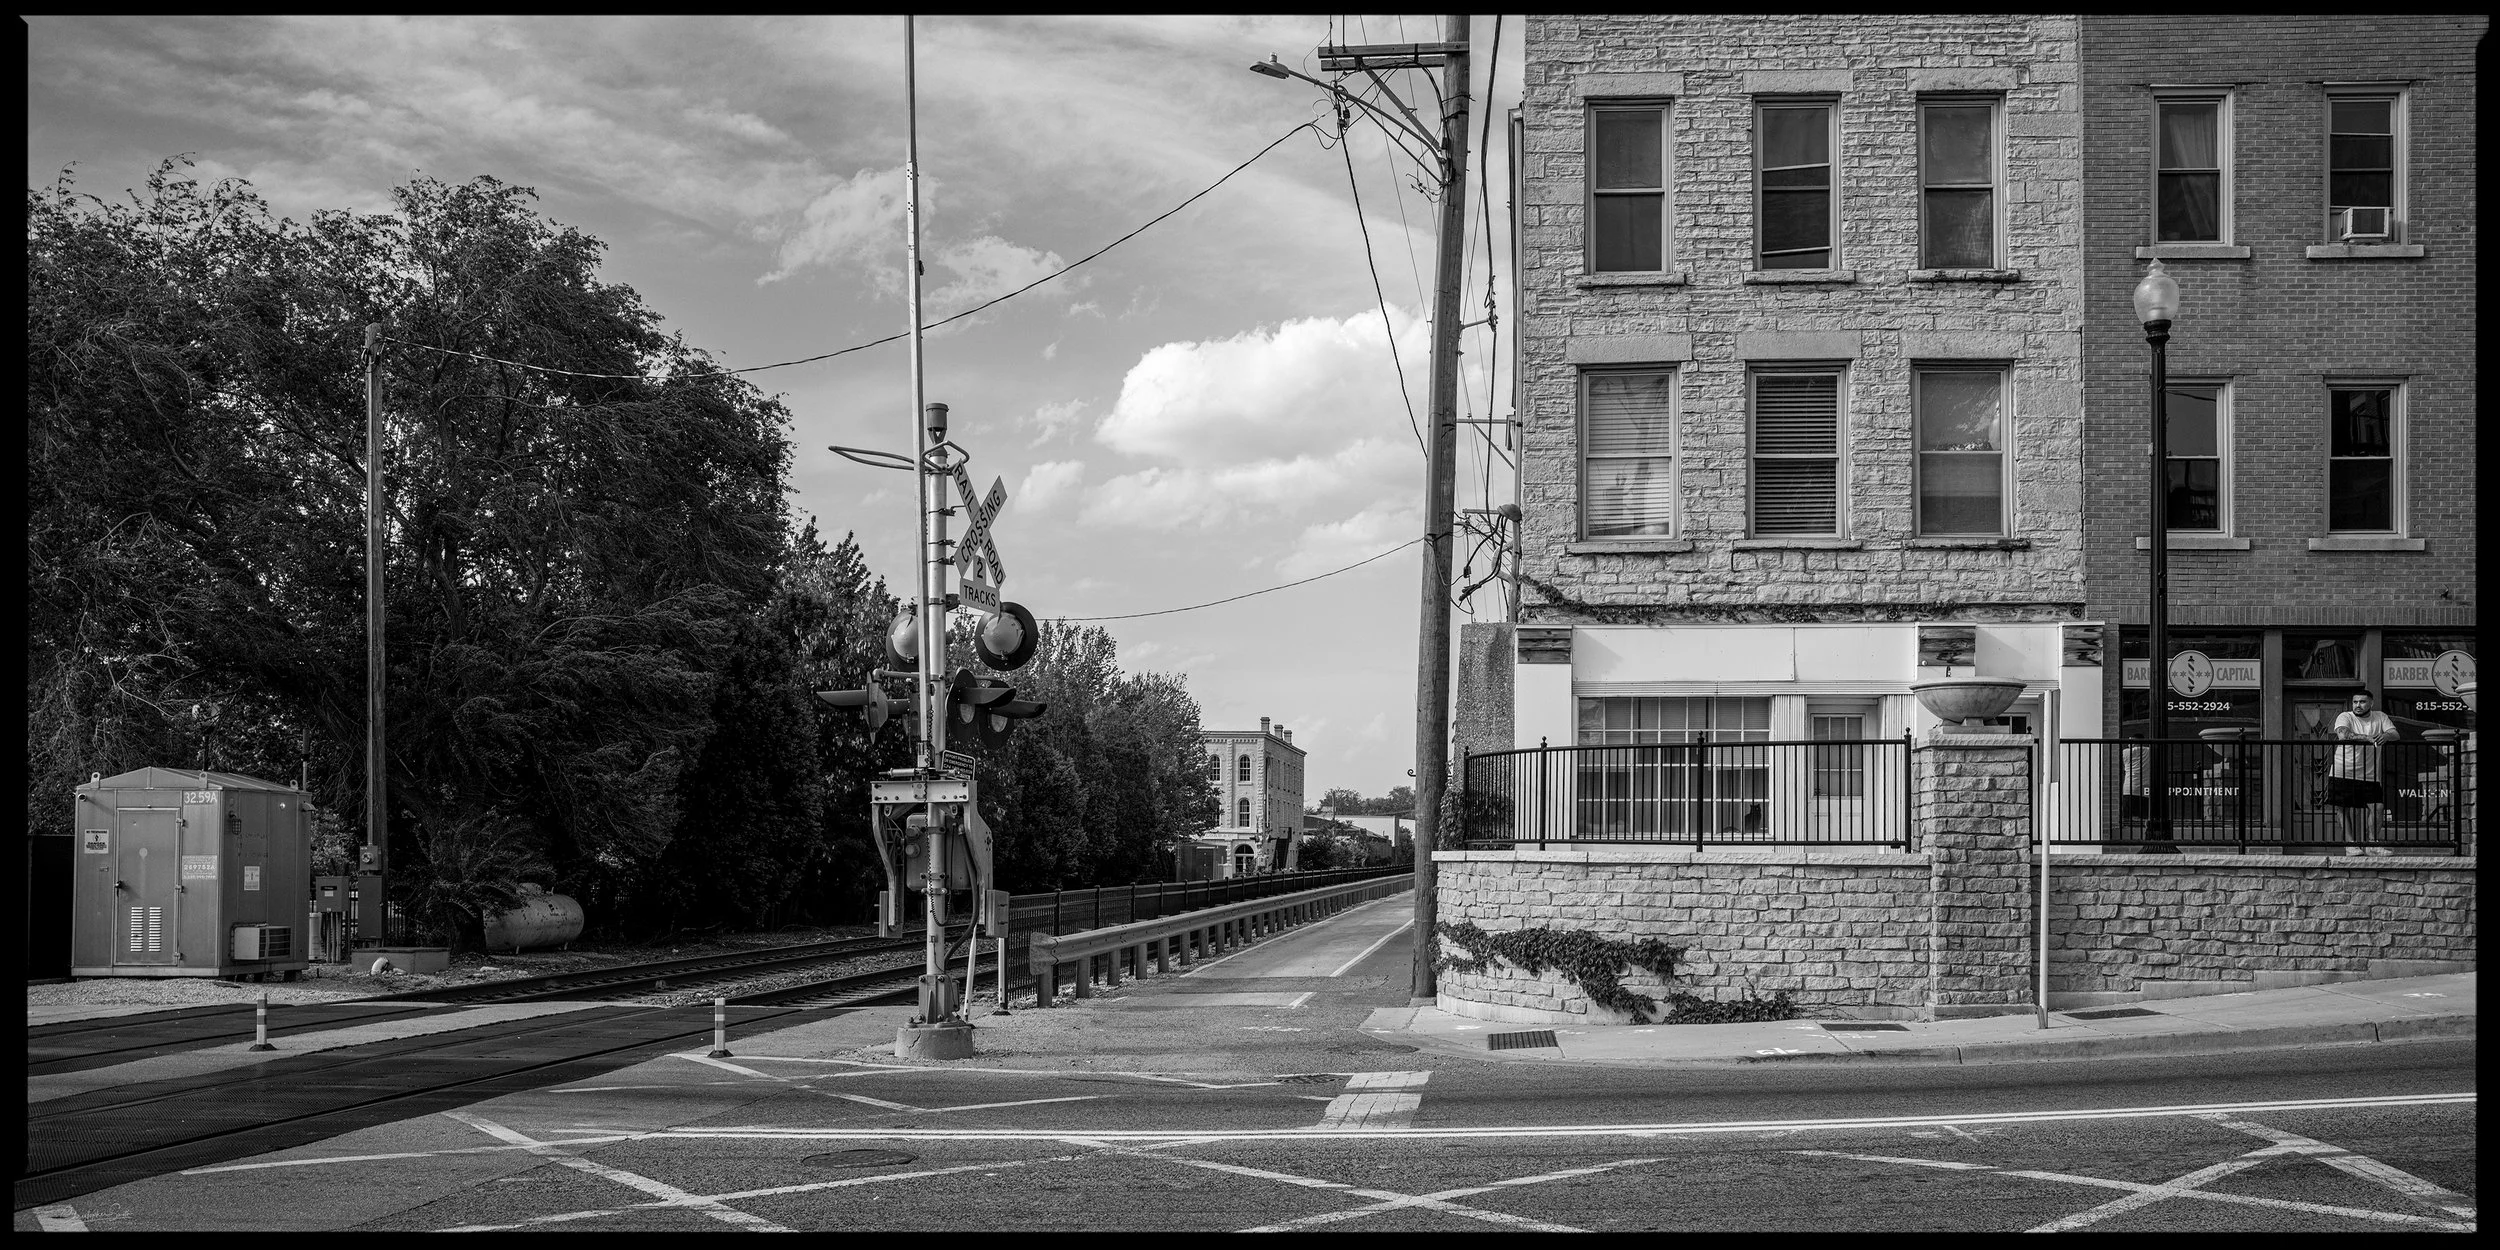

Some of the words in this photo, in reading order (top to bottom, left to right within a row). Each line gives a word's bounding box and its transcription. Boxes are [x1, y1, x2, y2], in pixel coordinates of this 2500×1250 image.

[954, 463, 974, 513] RAIL
[961, 490, 1000, 563] CROSSING
[984, 538, 1003, 584] ROAD
[976, 560, 984, 579] 2
[963, 584, 996, 608] TRACKS
[2216, 667, 2256, 681] CAPITAL
[2388, 667, 2429, 681] BARBER
[2167, 701, 2231, 711] 5-552-2924
[2415, 701, 2473, 711] 815-552-
[184, 791, 217, 804] 32.59A
[2168, 787, 2240, 796] PPOINTMENT
